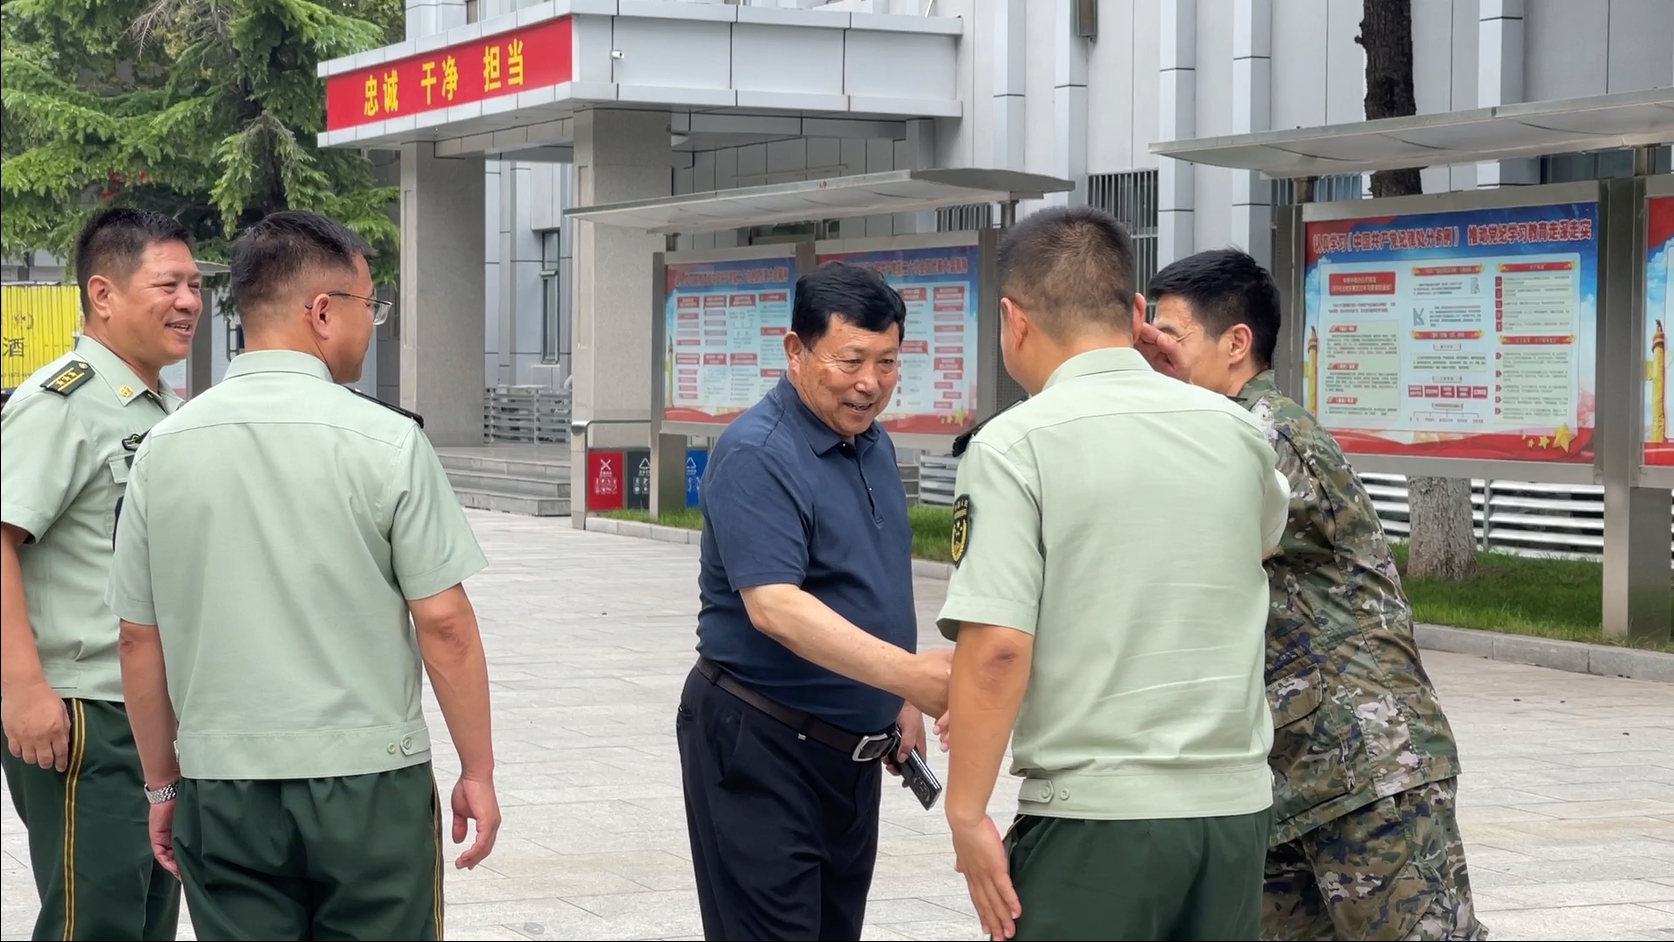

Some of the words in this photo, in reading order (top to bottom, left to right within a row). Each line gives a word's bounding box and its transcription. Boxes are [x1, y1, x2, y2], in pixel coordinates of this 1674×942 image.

[364, 69, 399, 117] 忠诚
[420, 55, 459, 105] 干净
[483, 38, 524, 92] 担当
[3, 337, 25, 358] 酒
